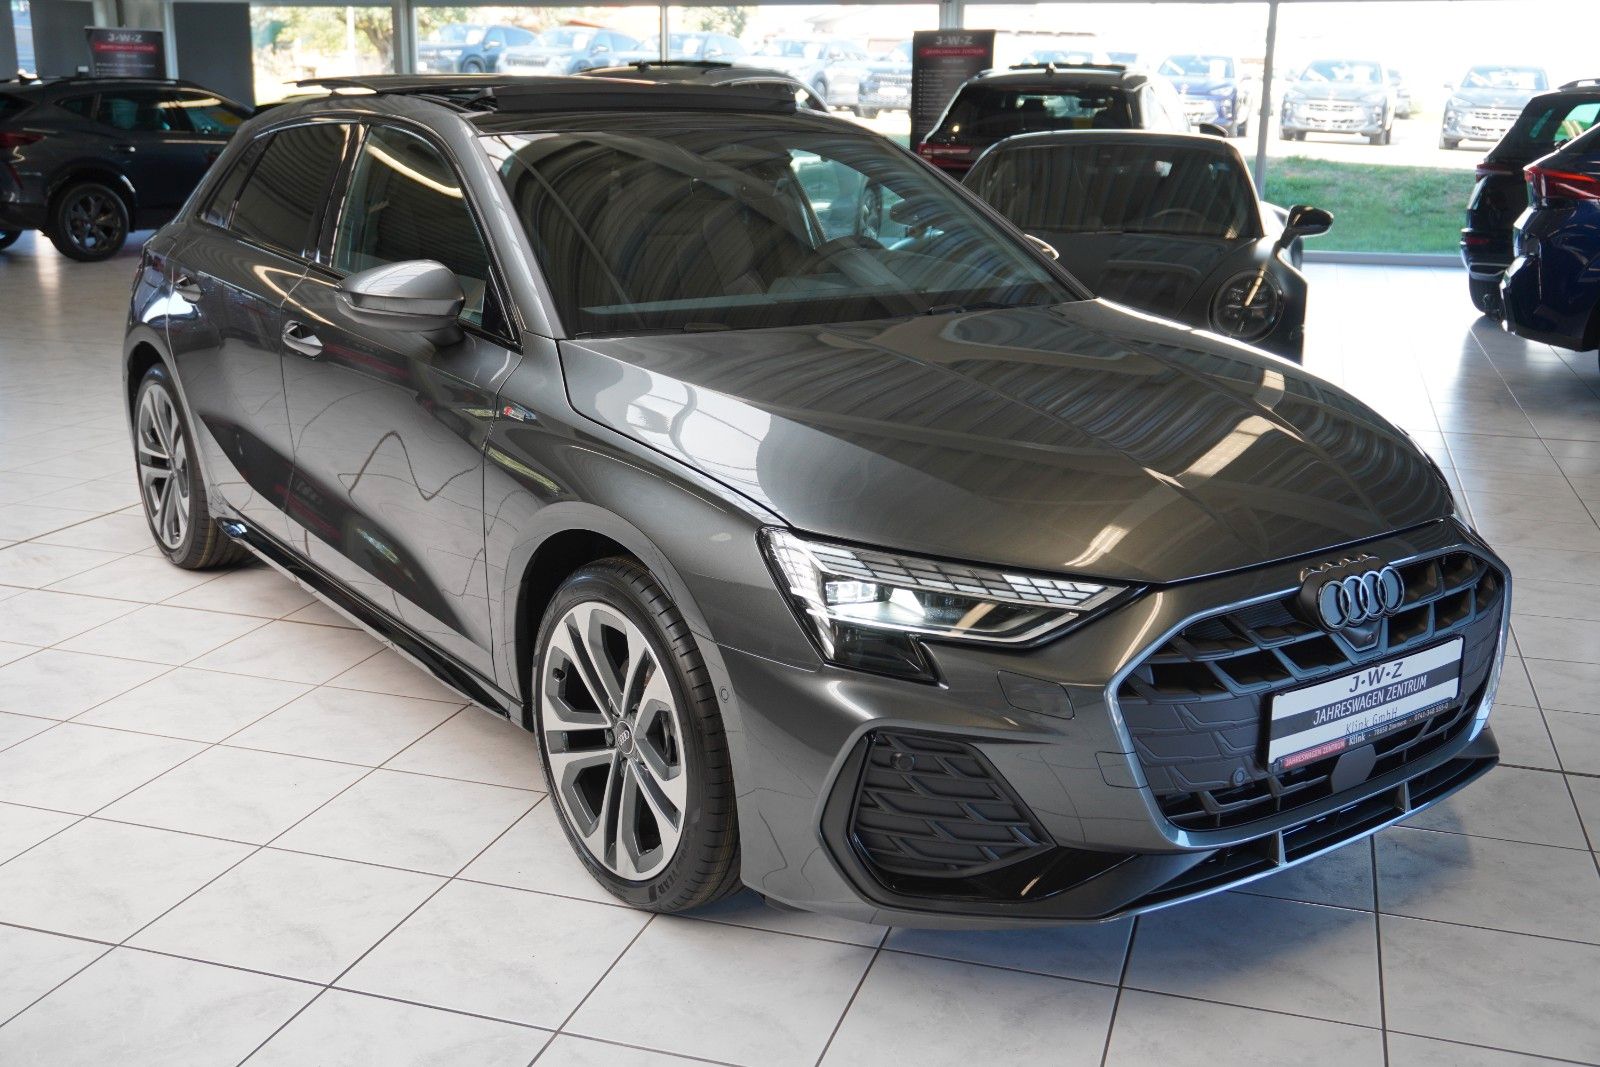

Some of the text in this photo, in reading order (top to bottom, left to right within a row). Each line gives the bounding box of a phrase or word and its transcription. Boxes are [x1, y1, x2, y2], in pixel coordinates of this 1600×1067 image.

[1313, 675, 1427, 725] JAHRESWAGEN ZENTRUM
[1345, 706, 1398, 735] Klink GmbH
[1286, 748, 1322, 765] JAHRESWAGEN
[1322, 740, 1345, 754] ZENTRUM
[1348, 732, 1366, 745] Klink
